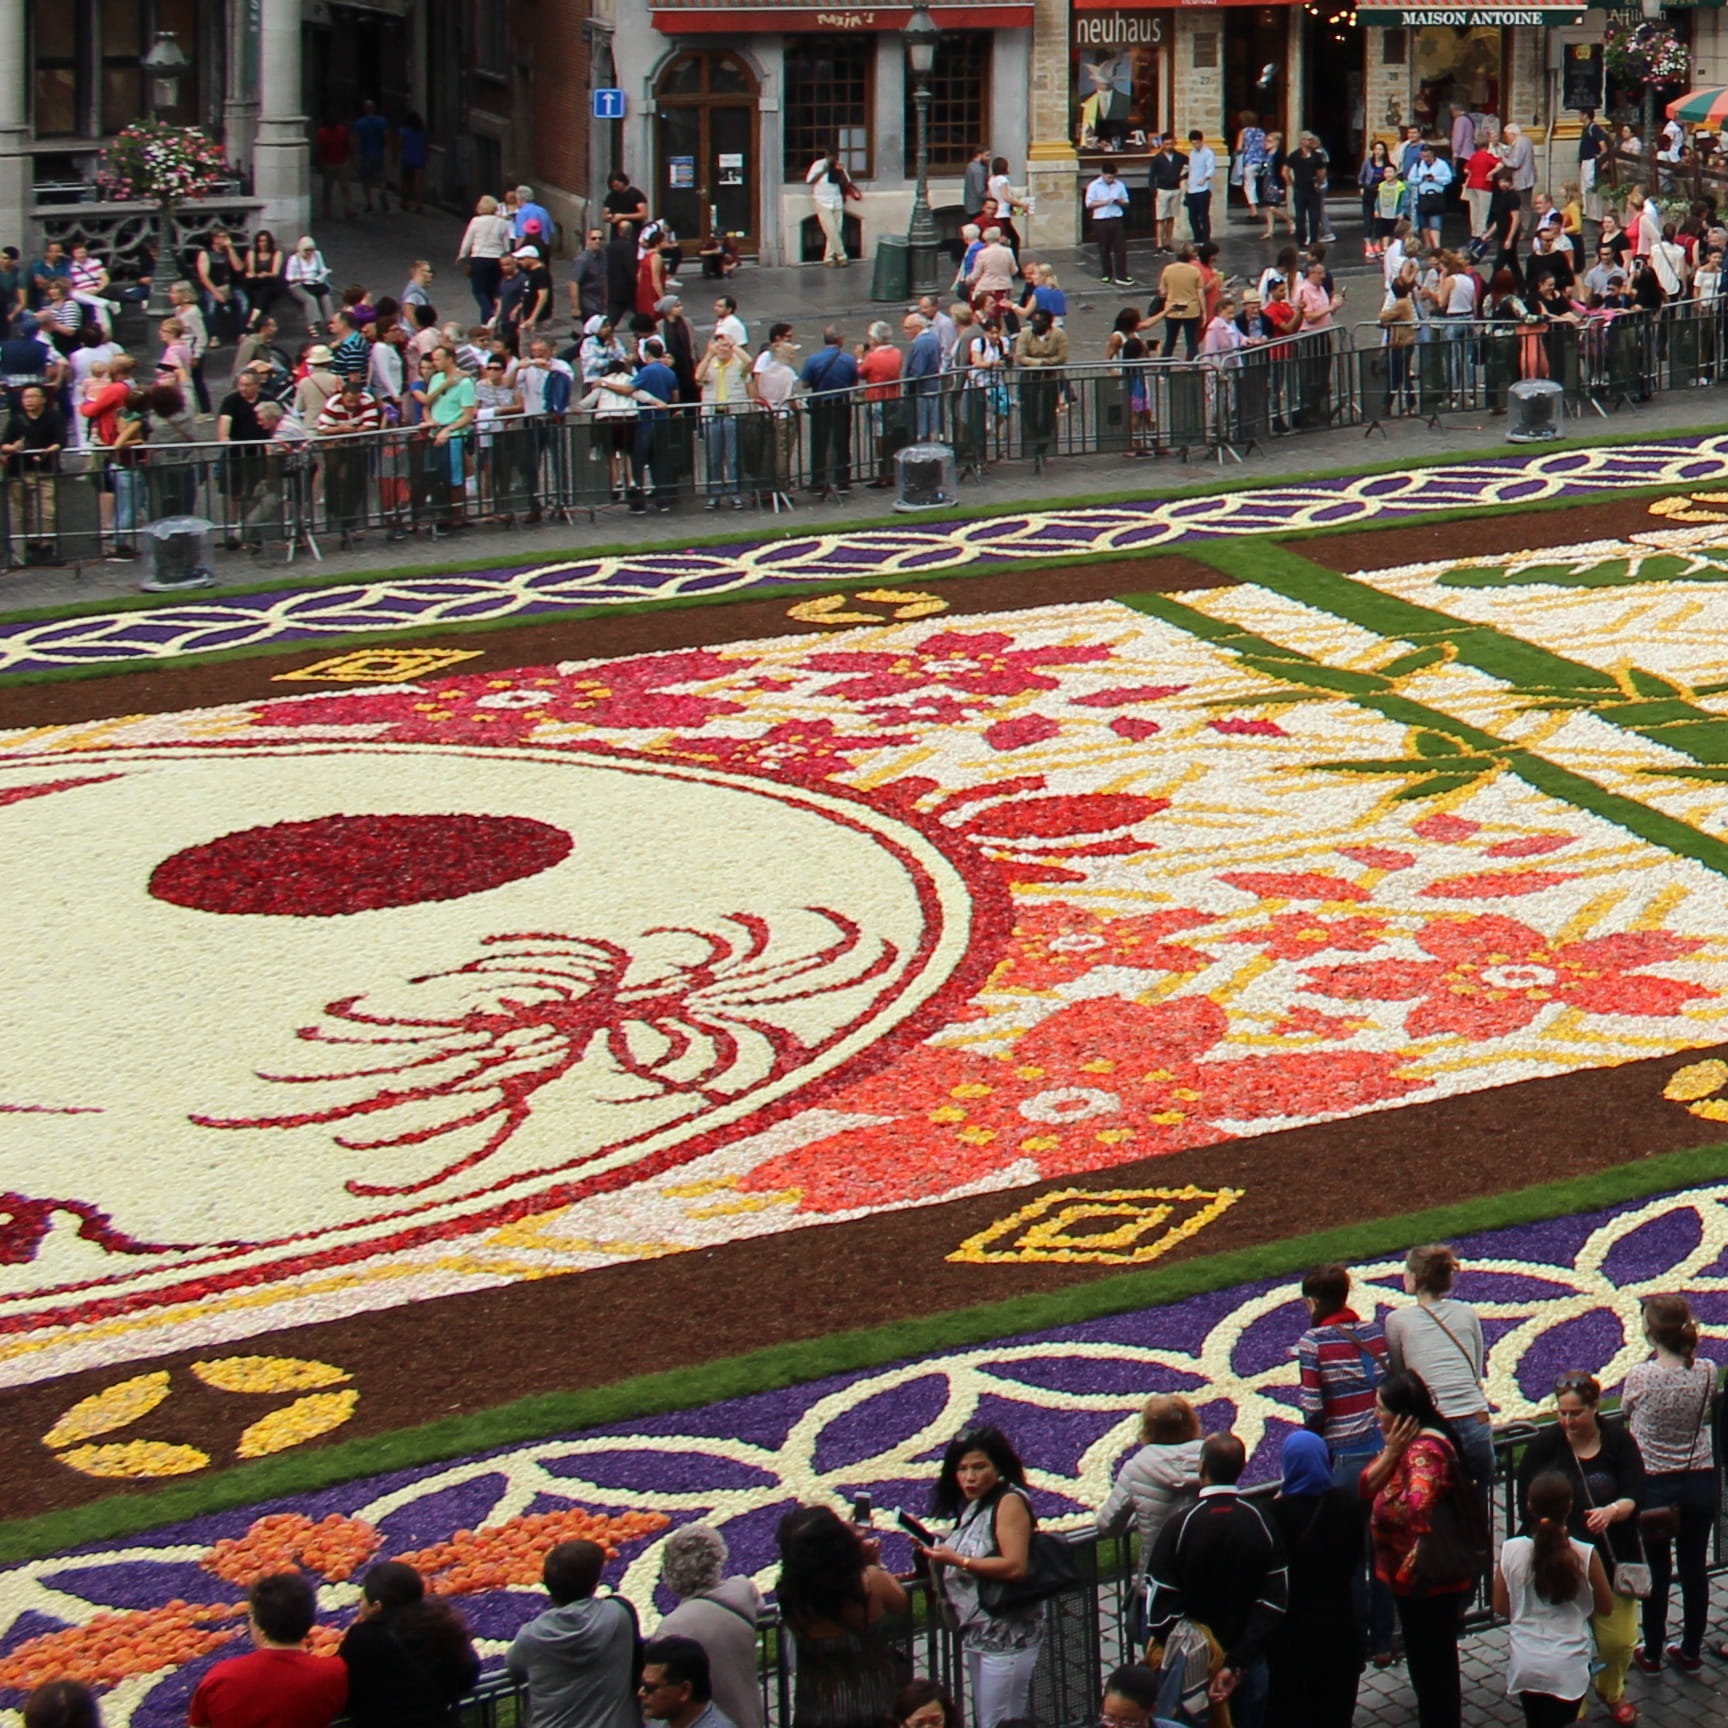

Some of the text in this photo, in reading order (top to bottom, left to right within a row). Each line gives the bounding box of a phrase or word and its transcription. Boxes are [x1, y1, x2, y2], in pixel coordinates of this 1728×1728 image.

[1076, 10, 1161, 44] neuhaus
[1401, 11, 1543, 25] MAISON ANTOINE
